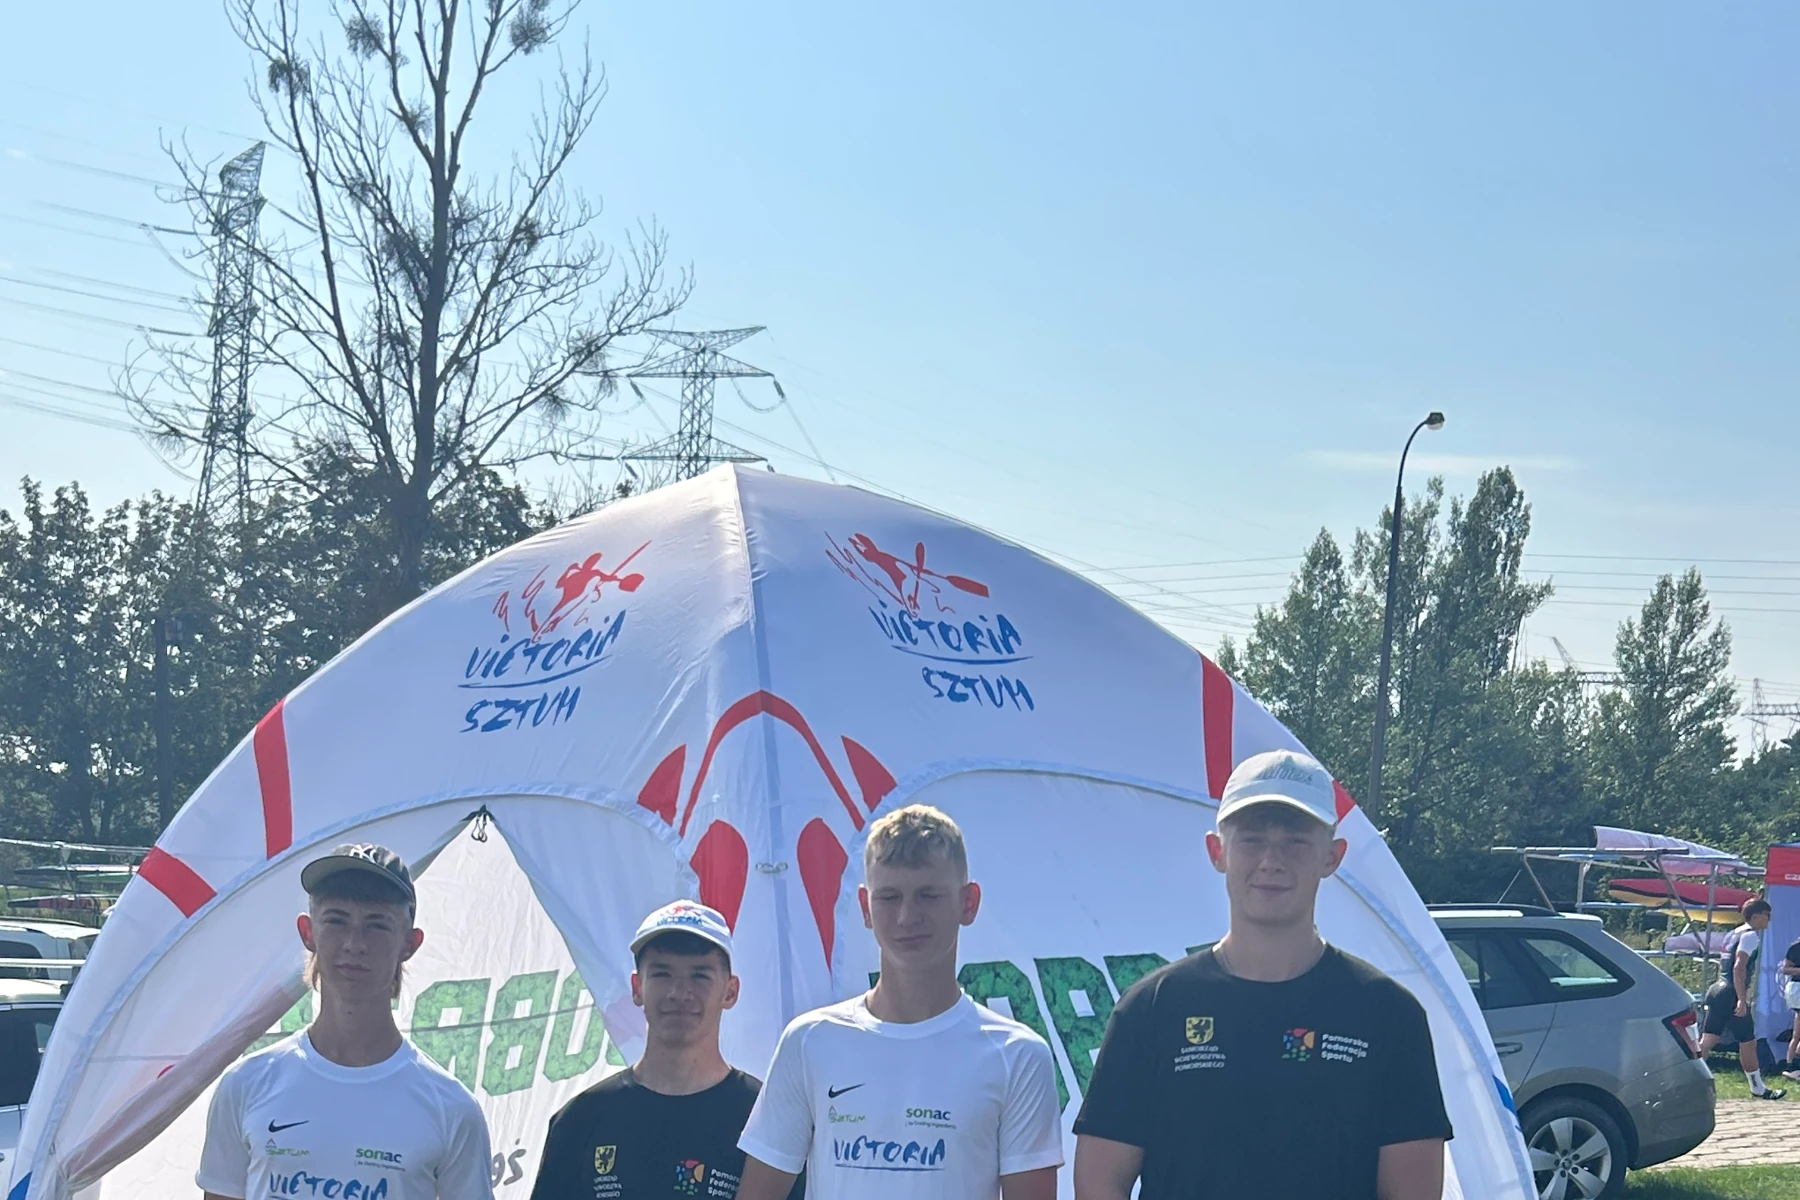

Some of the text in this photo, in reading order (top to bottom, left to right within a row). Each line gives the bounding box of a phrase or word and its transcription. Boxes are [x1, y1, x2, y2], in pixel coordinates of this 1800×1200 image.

[922, 666, 1036, 712] SZTUM
[459, 686, 581, 733] SZTUM
[905, 1107, 951, 1121] sonac
[355, 1148, 403, 1164] sonac
[834, 1135, 946, 1166] VICTORIA
